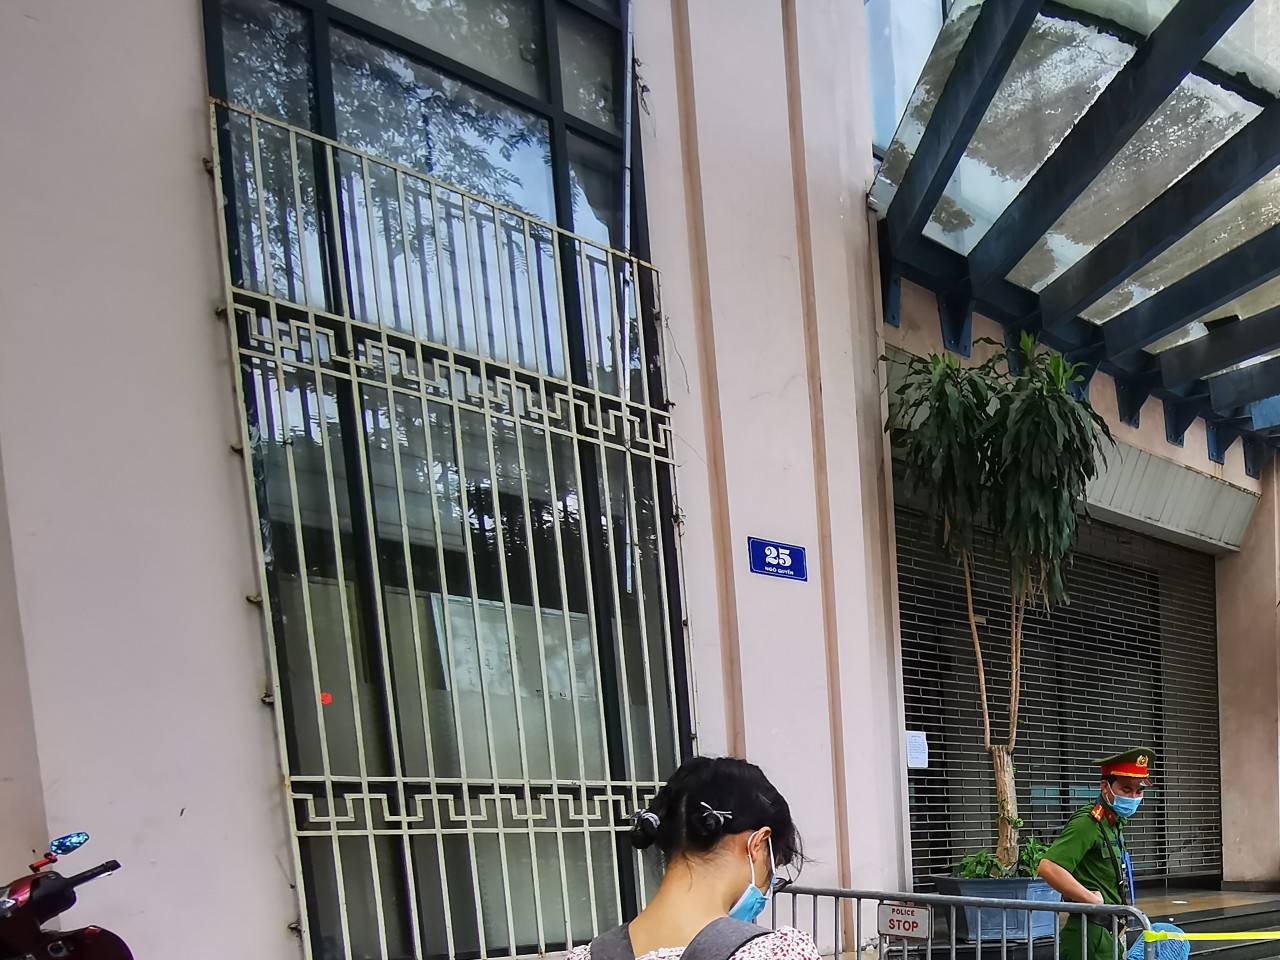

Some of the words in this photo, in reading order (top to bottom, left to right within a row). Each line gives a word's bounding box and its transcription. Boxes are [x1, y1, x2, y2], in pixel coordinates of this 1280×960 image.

[765, 546, 792, 566] 25
[892, 908, 916, 916] POLICE
[888, 918, 919, 932] STOP
